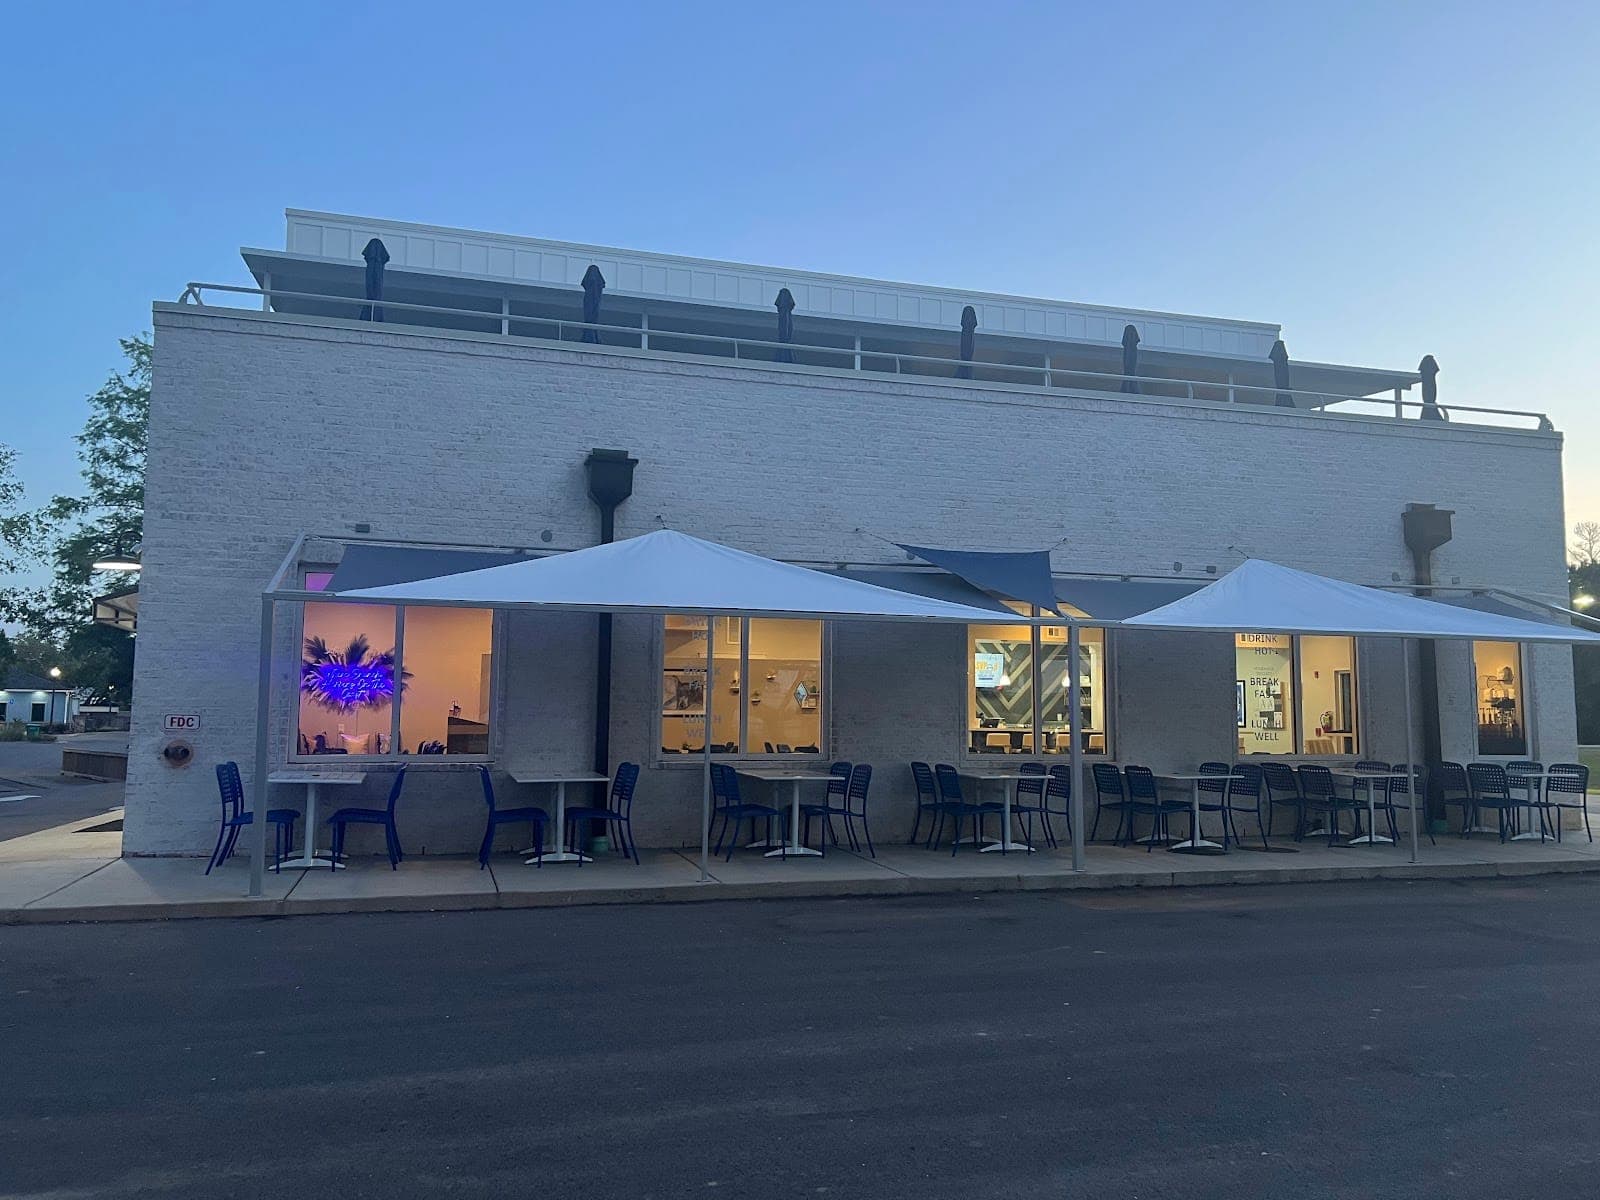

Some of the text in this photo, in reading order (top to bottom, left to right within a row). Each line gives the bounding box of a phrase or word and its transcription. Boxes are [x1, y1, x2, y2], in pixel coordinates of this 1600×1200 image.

[1248, 634, 1278, 643] DRINK
[683, 666, 721, 675] BREK
[1250, 677, 1279, 686] BREAK
[170, 716, 194, 728] FDC
[683, 714, 722, 724] LUNH
[1251, 719, 1281, 729] LUNH
[1254, 732, 1280, 741] WELL
